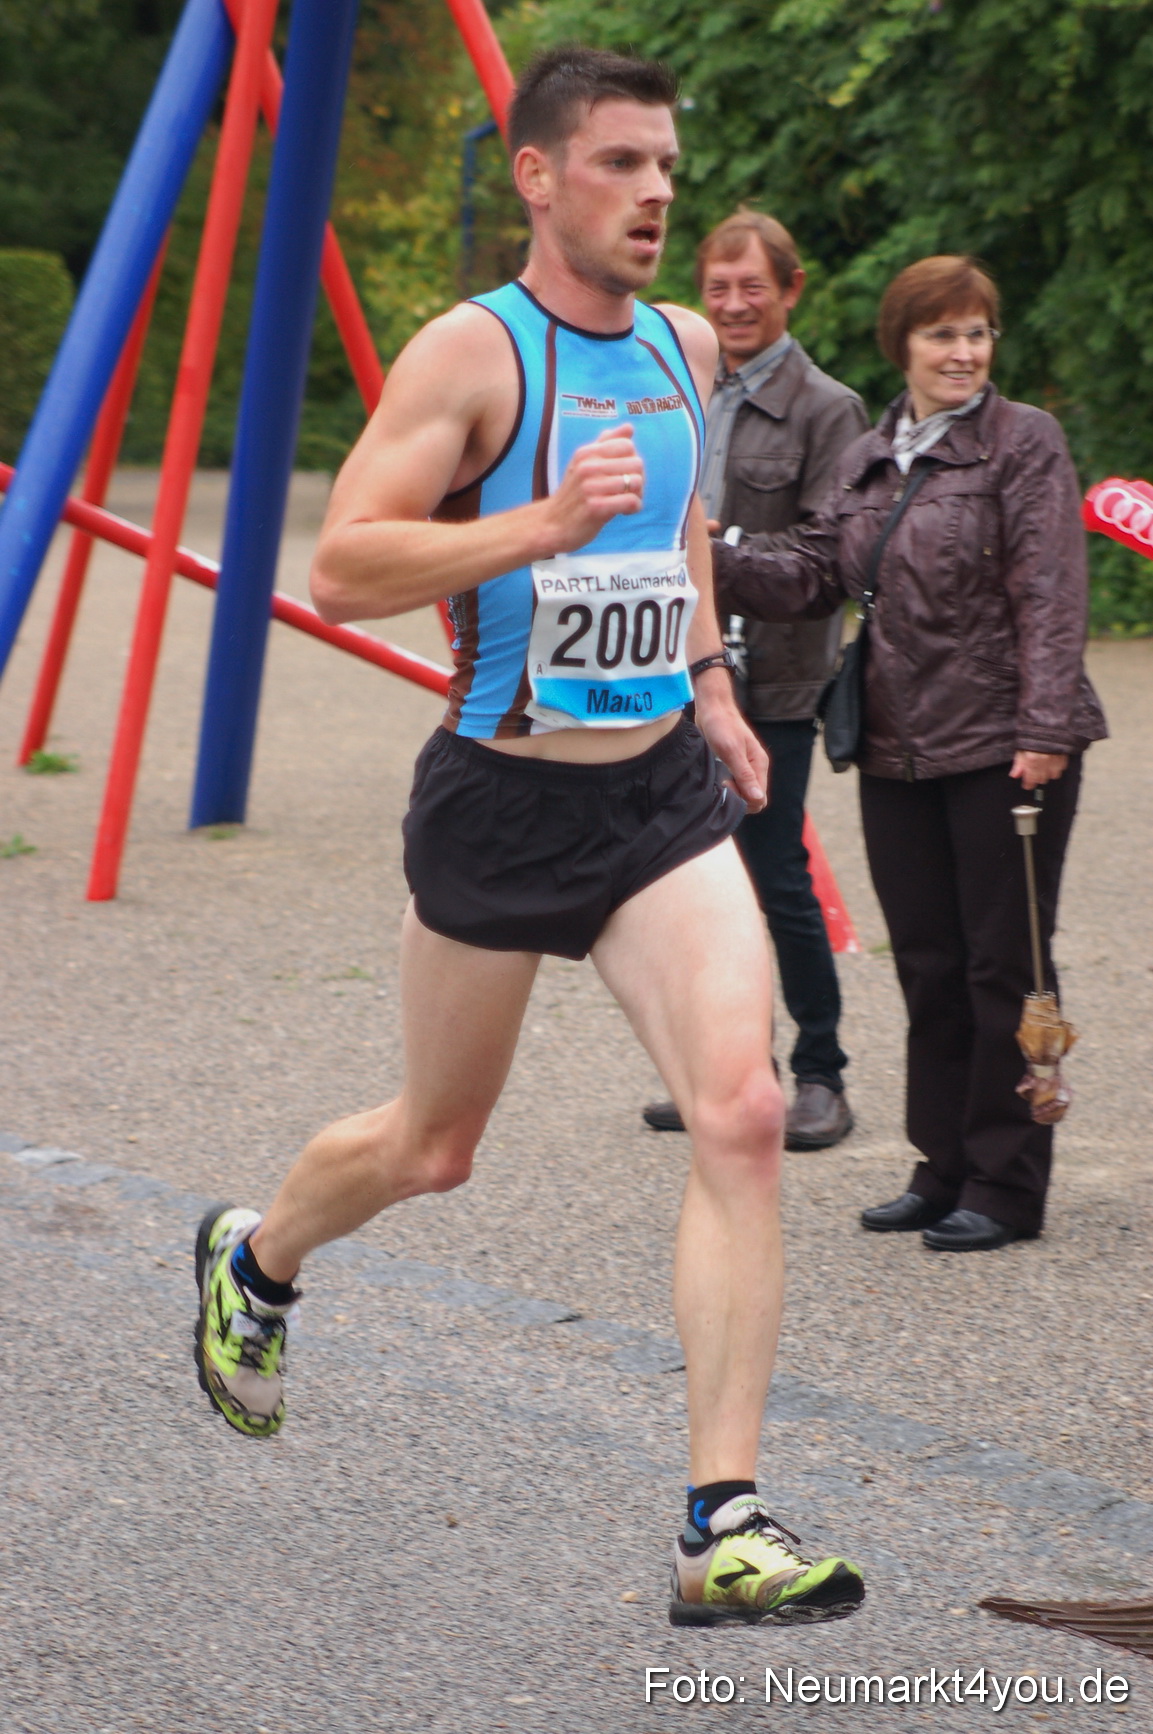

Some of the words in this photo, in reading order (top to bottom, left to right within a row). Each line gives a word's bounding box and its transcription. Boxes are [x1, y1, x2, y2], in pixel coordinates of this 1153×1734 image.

[541, 576, 605, 593] PARTL
[610, 571, 676, 592] Neumarkt
[550, 597, 685, 670] 2000
[536, 663, 543, 675] A
[586, 689, 653, 714] Marco
